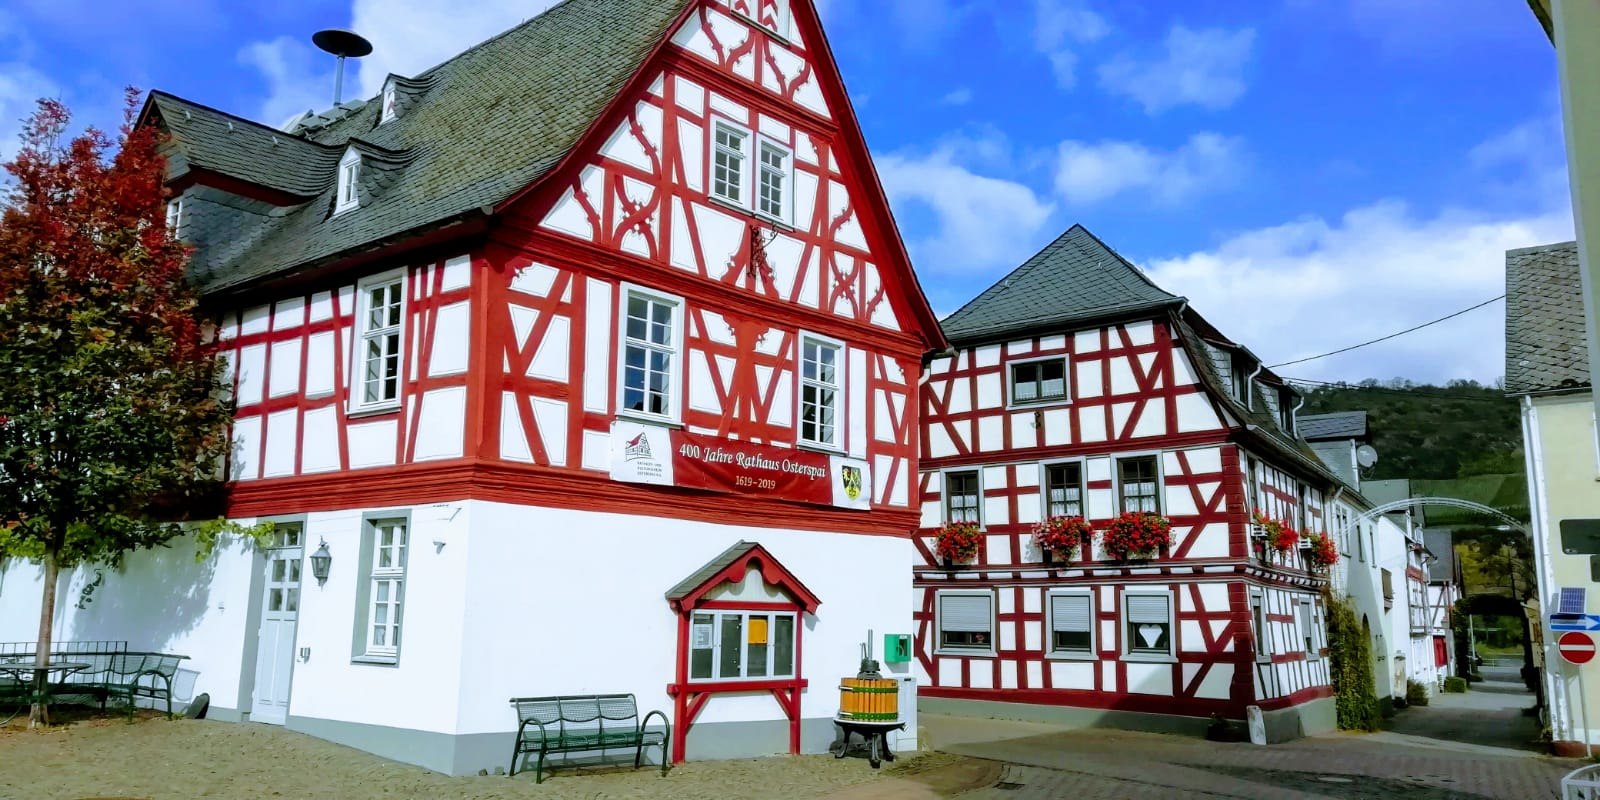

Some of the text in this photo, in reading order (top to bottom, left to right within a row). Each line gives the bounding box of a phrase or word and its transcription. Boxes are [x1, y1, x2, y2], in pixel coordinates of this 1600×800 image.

[679, 443, 826, 481] 400 Jahre Rathaus Osterspai
